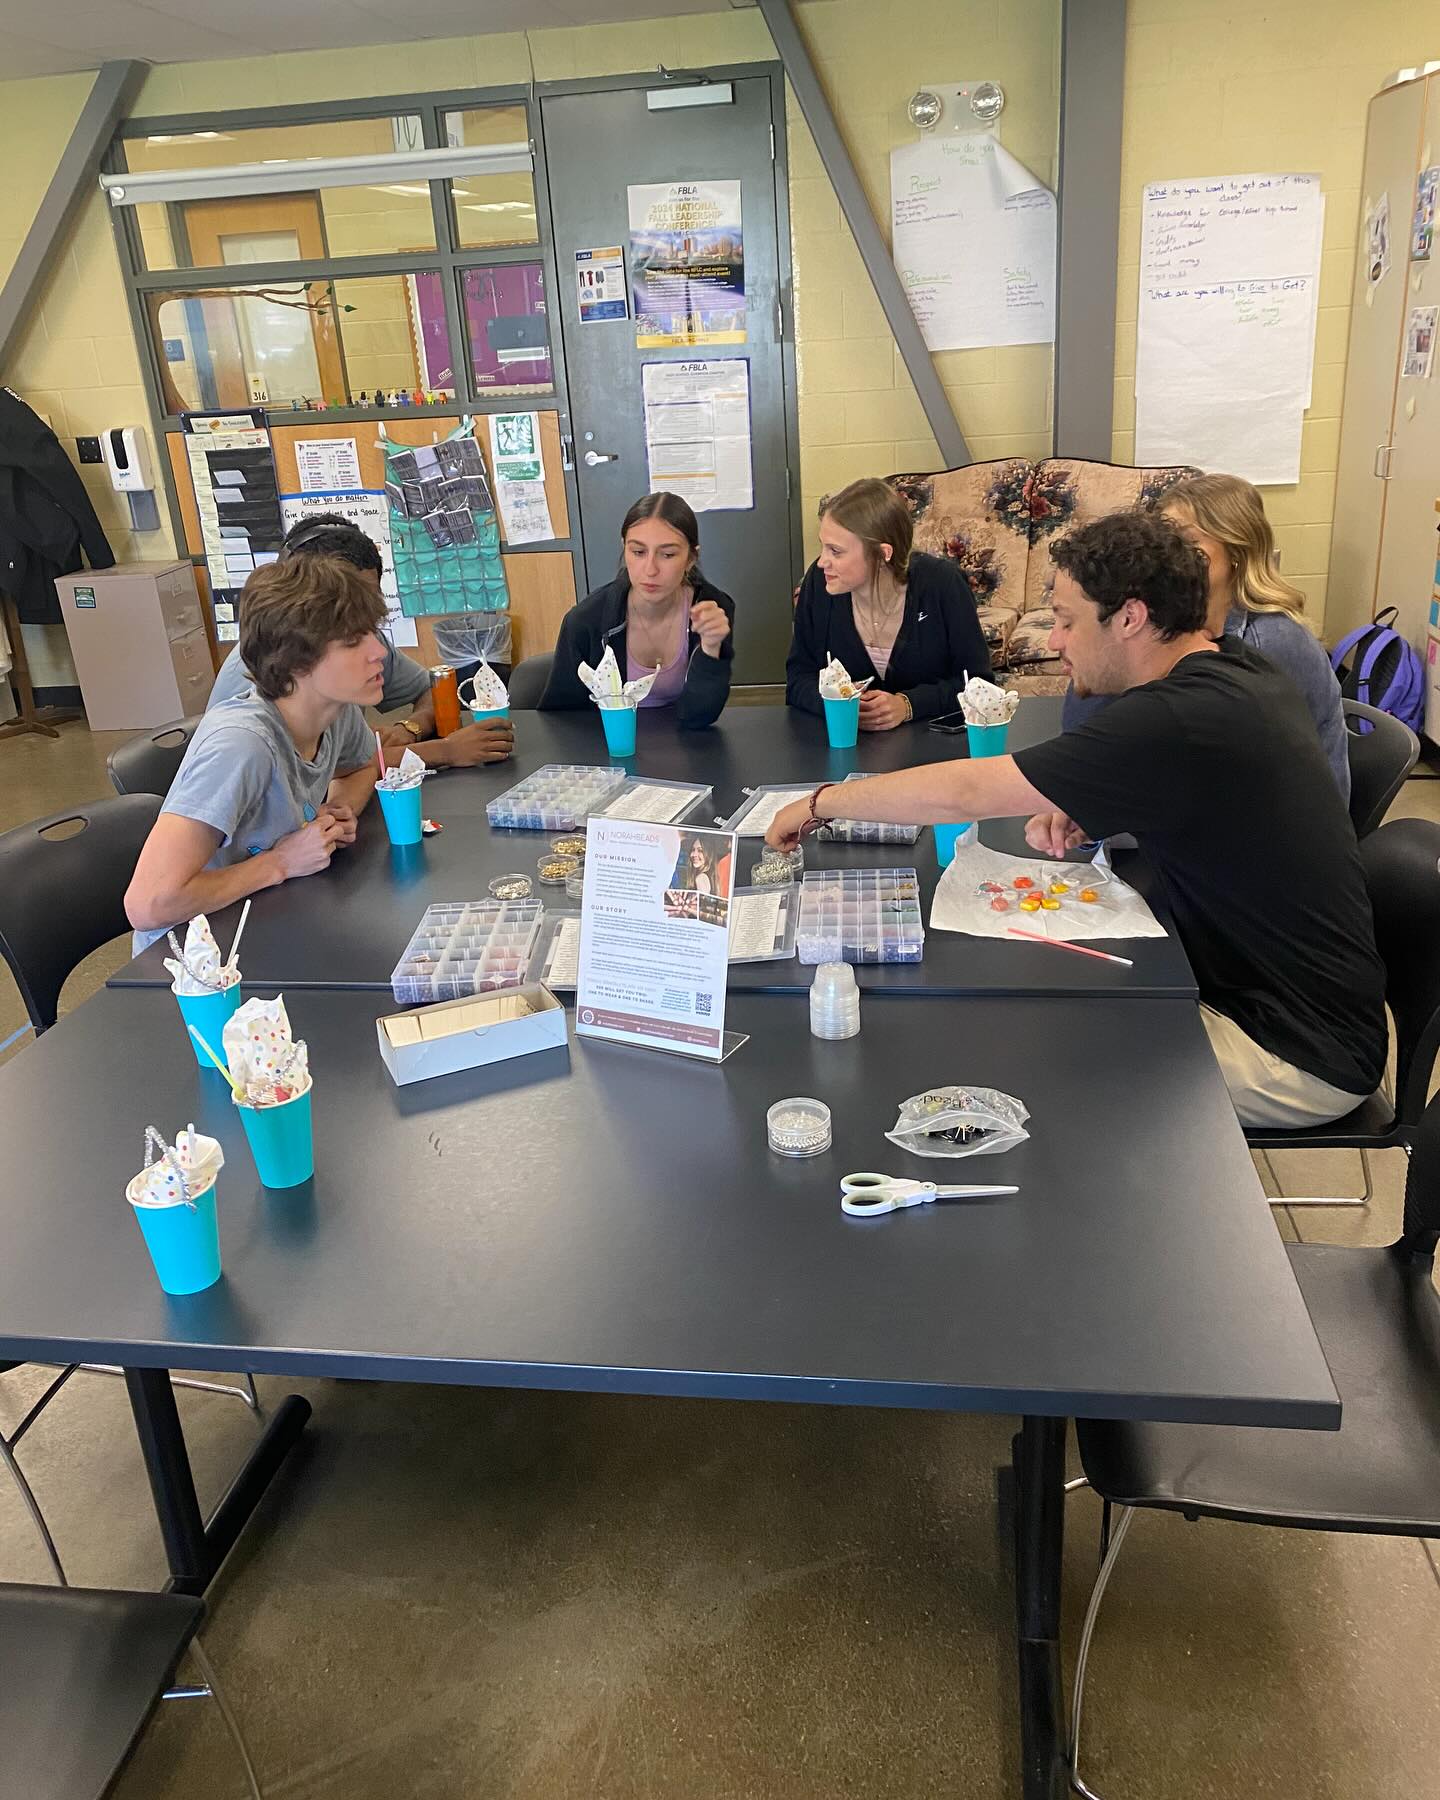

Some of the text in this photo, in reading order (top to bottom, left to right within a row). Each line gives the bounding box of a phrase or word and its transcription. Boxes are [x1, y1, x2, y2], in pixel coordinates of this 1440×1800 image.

[677, 186, 698, 195] FBLA
[1149, 187, 1167, 197] What
[1185, 187, 1201, 199] you
[1206, 183, 1224, 193] want
[675, 201, 719, 212] NATIONAL
[671, 210, 723, 221] LEADERSHIP
[688, 363, 708, 372] FBLA
[253, 392, 267, 400] 316
[301, 496, 320, 505] What
[284, 509, 298, 519] Give
[597, 831, 660, 842] N NORAHBEADS
[610, 855, 636, 863] MISSION
[606, 906, 626, 914] STORY
